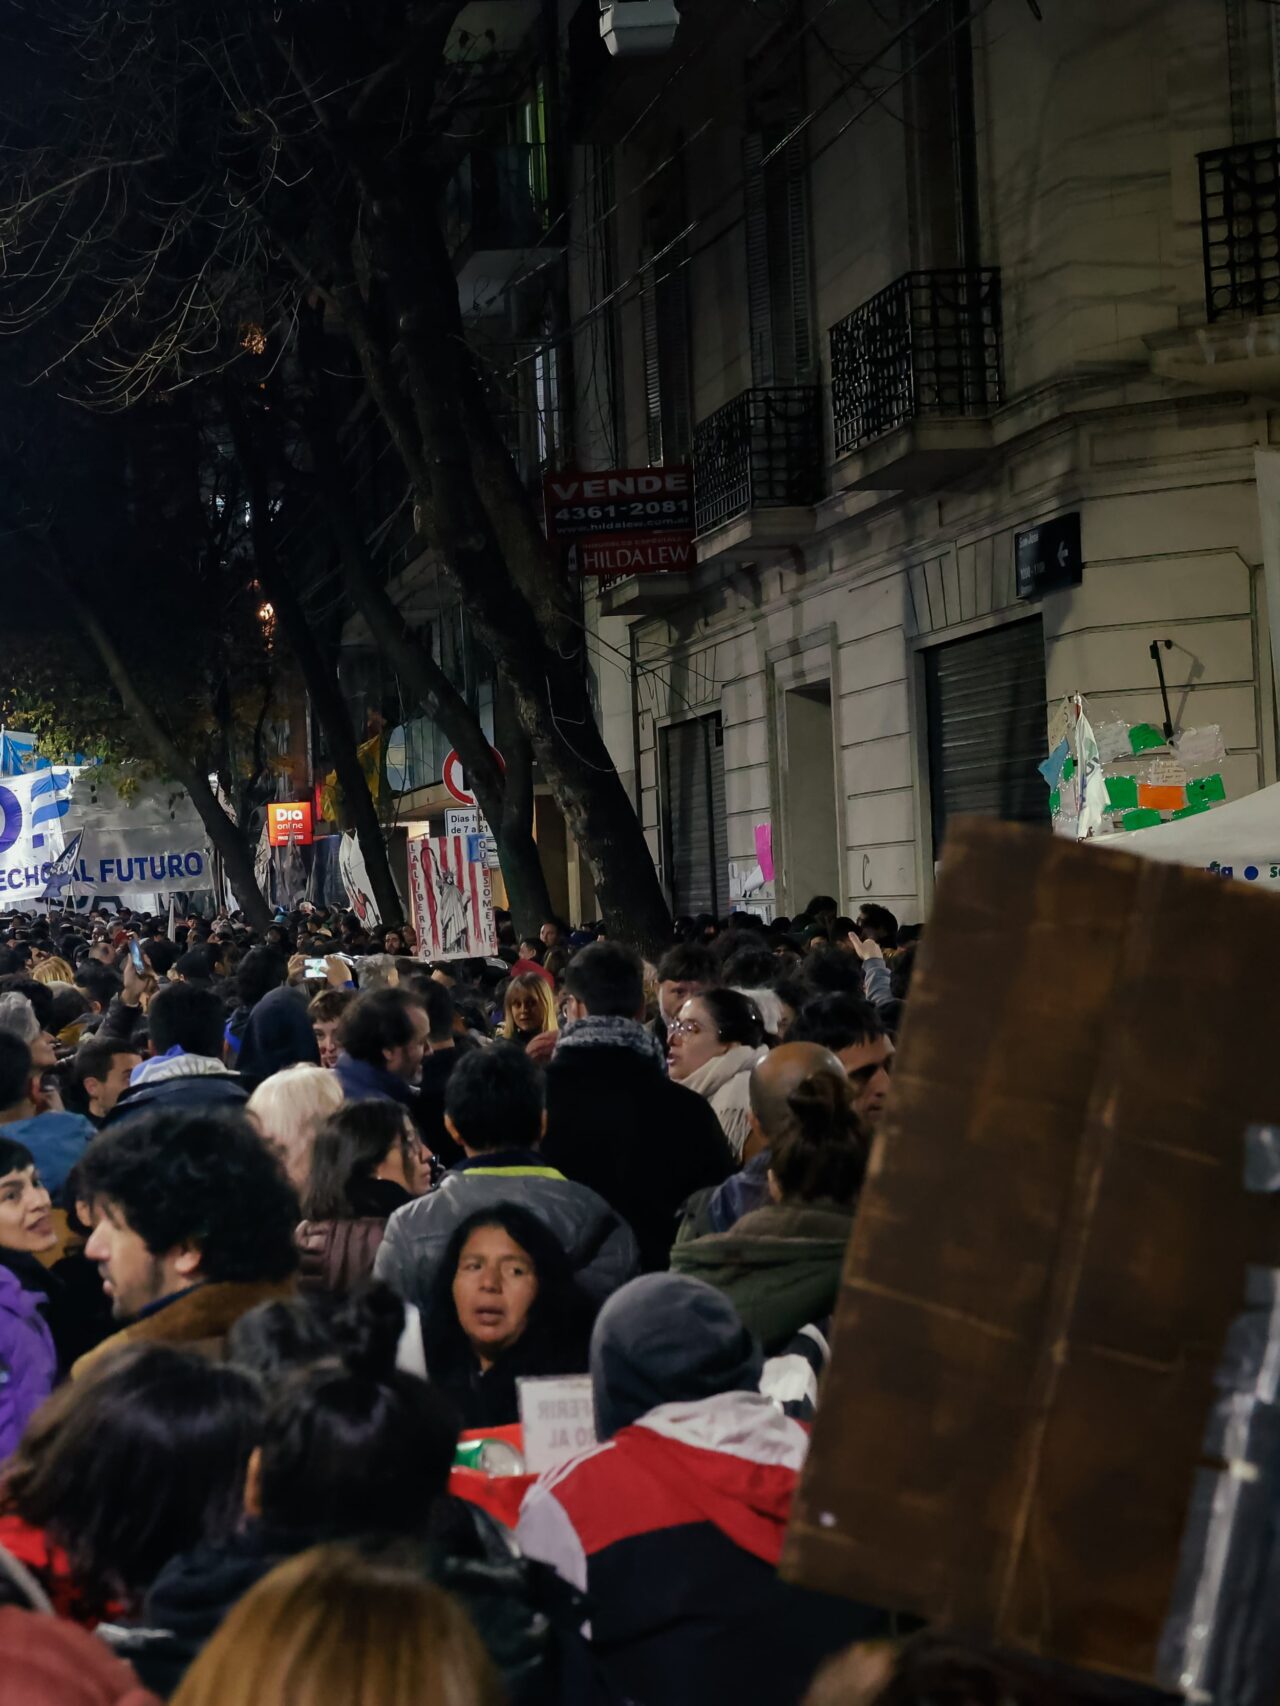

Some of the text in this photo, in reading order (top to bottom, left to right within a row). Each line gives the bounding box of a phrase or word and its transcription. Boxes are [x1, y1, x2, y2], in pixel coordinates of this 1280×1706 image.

[552, 473, 689, 500] VENDE
[555, 499, 688, 520] 4361-2081
[584, 545, 690, 569] HILDA LEW
[451, 826, 461, 834] de
[464, 825, 469, 833] 7
[479, 825, 488, 833] 21
[99, 852, 203, 882] FUTURO
